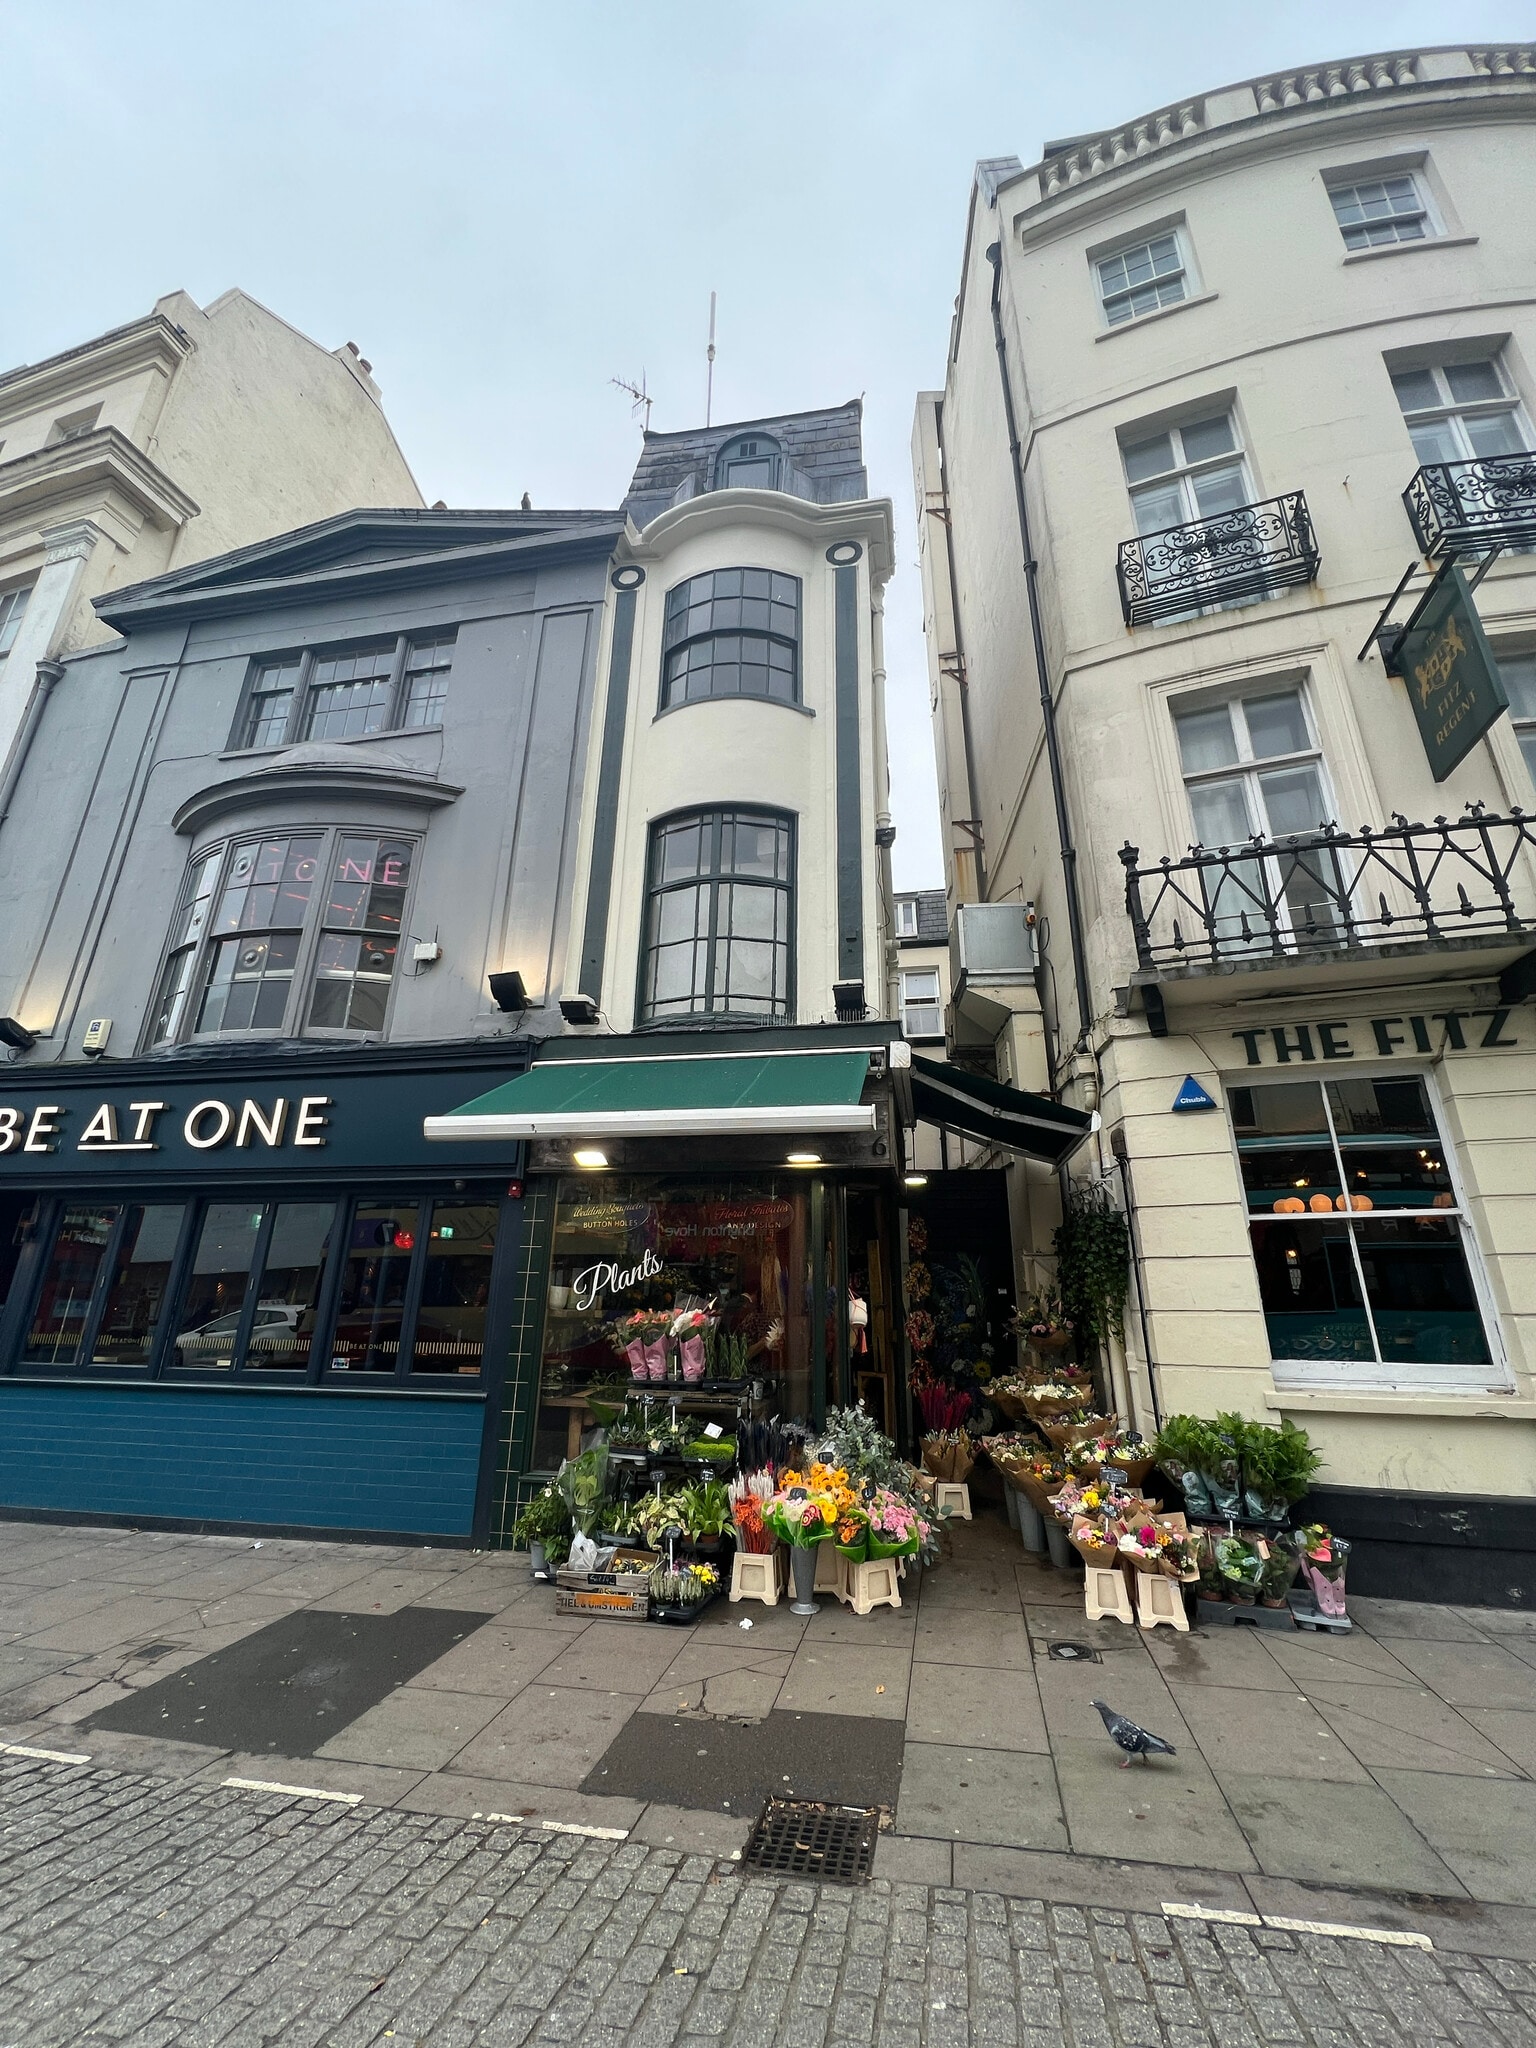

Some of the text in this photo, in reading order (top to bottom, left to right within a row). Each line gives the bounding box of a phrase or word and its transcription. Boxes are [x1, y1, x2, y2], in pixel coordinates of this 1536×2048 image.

[1437, 680, 1463, 717] FITZ
[1435, 688, 1478, 746] REGENT
[295, 857, 403, 885] ONE
[1232, 1009, 1518, 1065] THE FITZ
[1180, 1096, 1206, 1105] Chubb
[78, 1102, 168, 1146] AT
[184, 1097, 331, 1150] ONE
[871, 1134, 887, 1156] 6
[573, 1205, 606, 1219] Wedding
[714, 1203, 789, 1220] Floral Tributes
[583, 1219, 638, 1229] BUTTON HOLES
[748, 1221, 782, 1229] DESIGN
[573, 1248, 664, 1312] Plants
[349, 1342, 383, 1350] BE AT ONE
